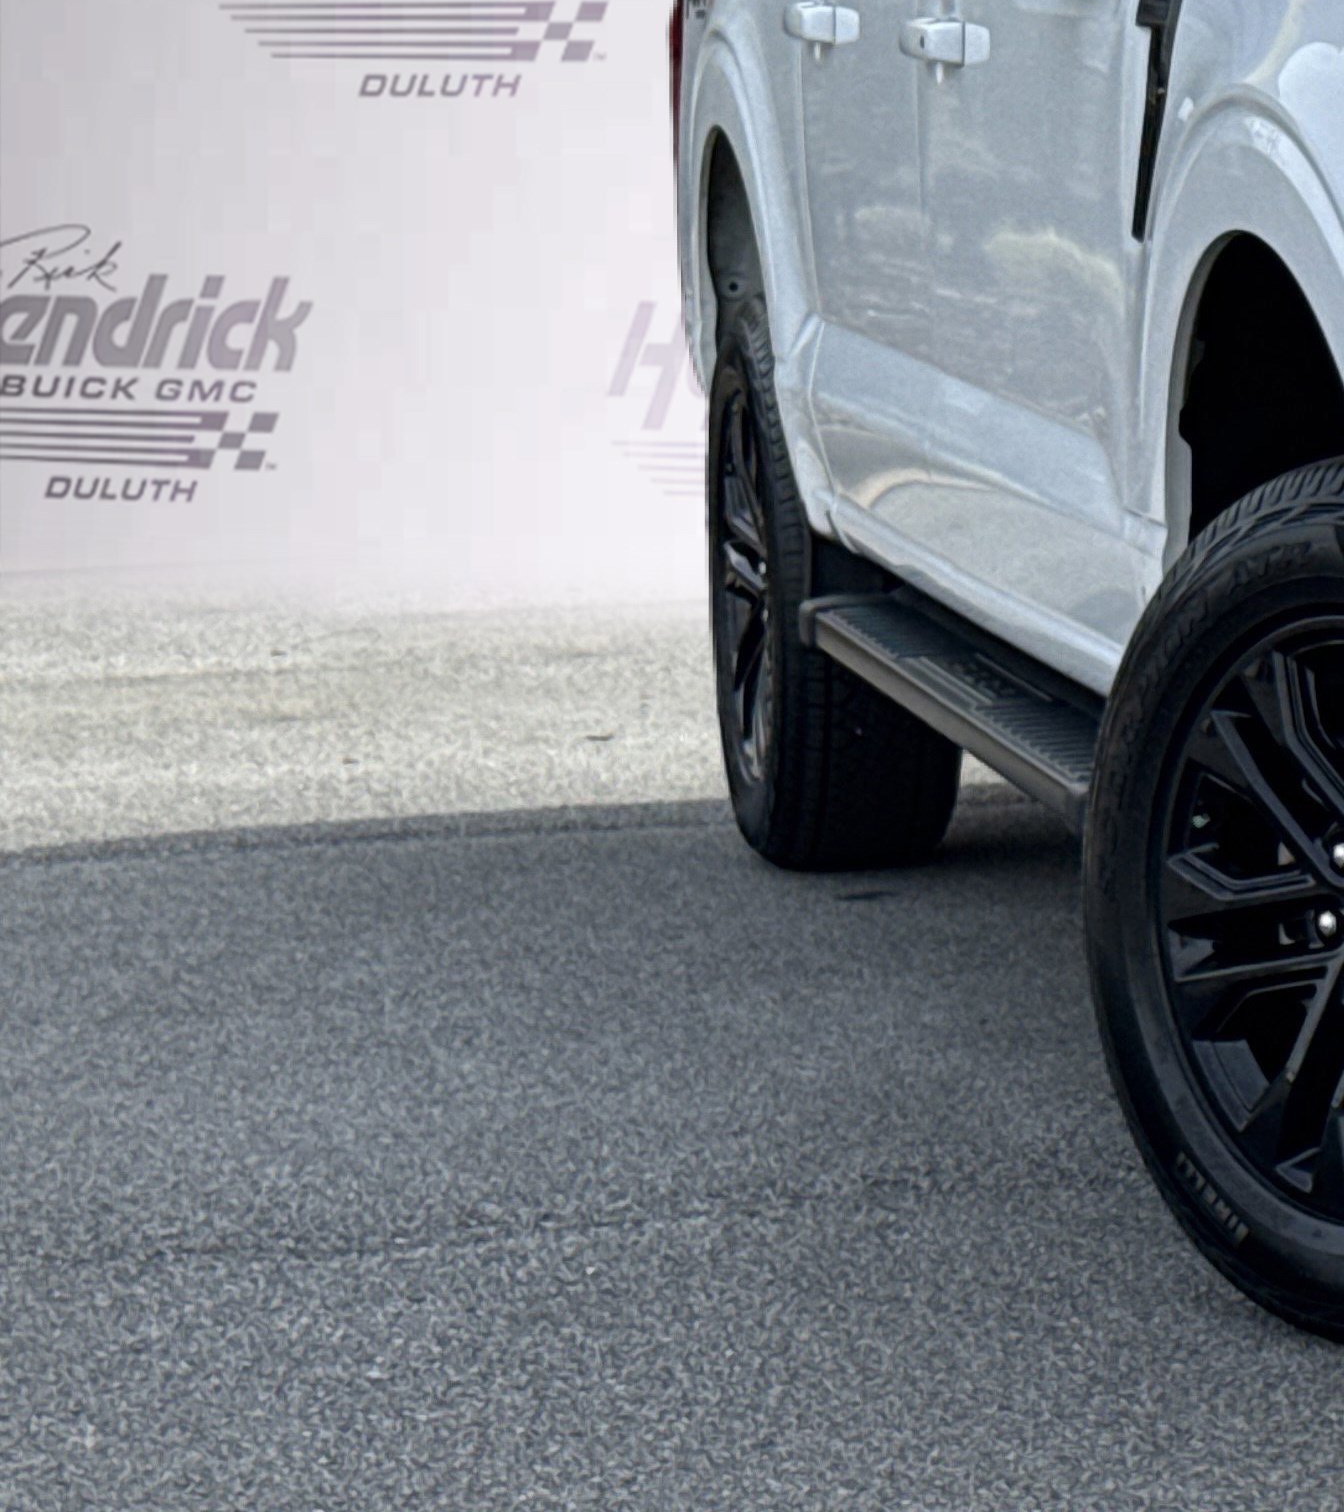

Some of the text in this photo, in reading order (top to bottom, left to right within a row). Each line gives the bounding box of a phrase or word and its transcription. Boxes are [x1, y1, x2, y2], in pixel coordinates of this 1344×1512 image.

[359, 74, 521, 97] DULUTH
[0, 274, 312, 372] endrick
[0, 374, 256, 403] BUICK GMC
[45, 476, 197, 502] DULUTH
